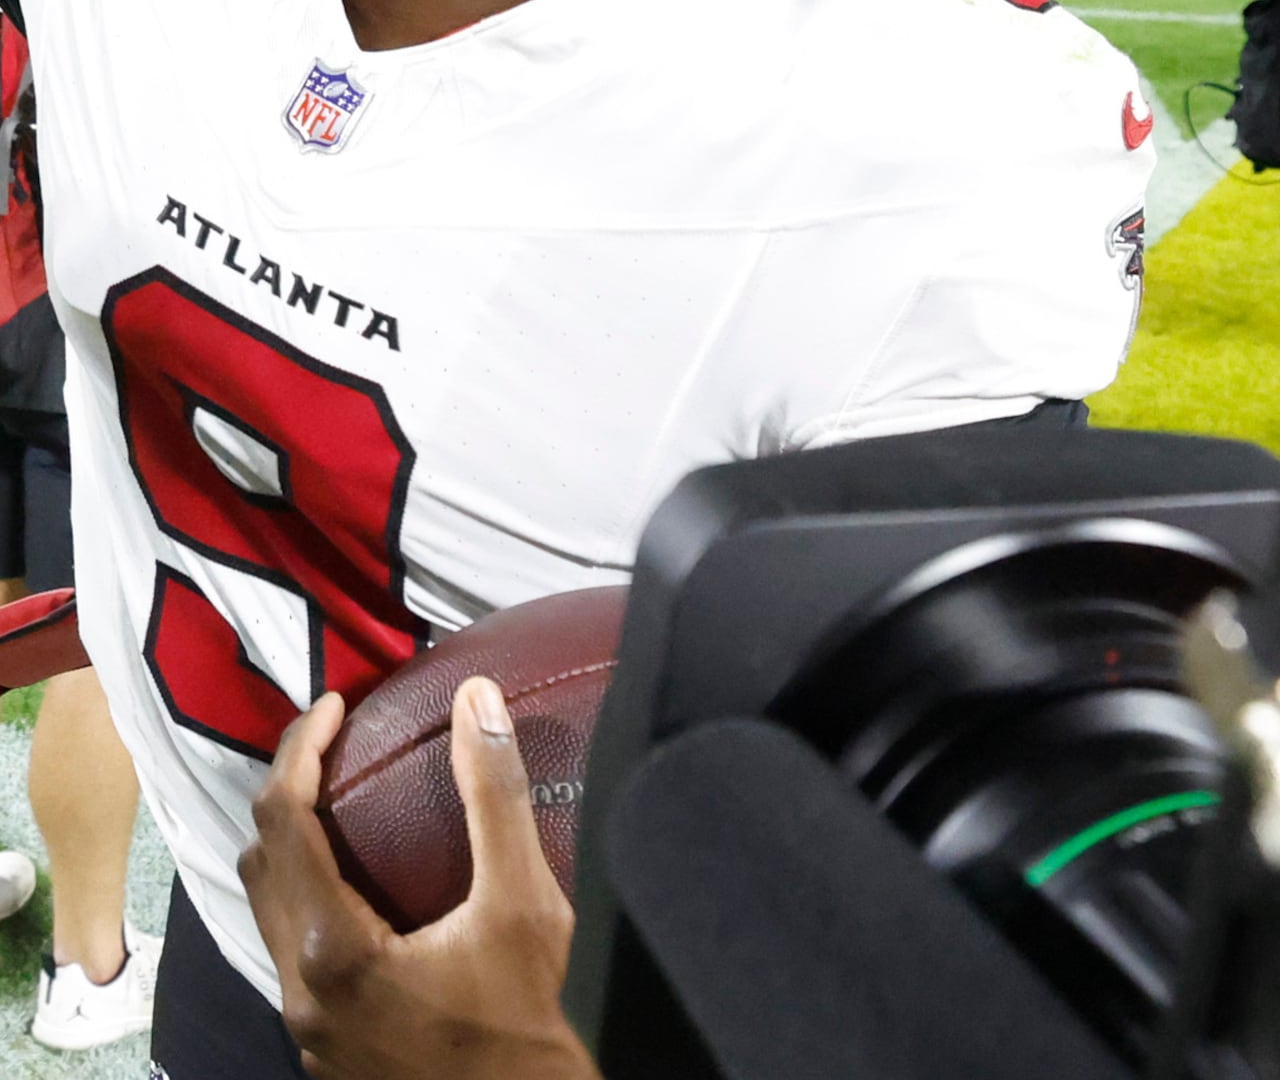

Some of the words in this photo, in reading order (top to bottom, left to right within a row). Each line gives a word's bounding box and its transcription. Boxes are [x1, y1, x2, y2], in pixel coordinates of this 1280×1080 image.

[293, 92, 342, 142] NFL
[156, 193, 402, 352] ATLANTA
[101, 264, 430, 765] 9
